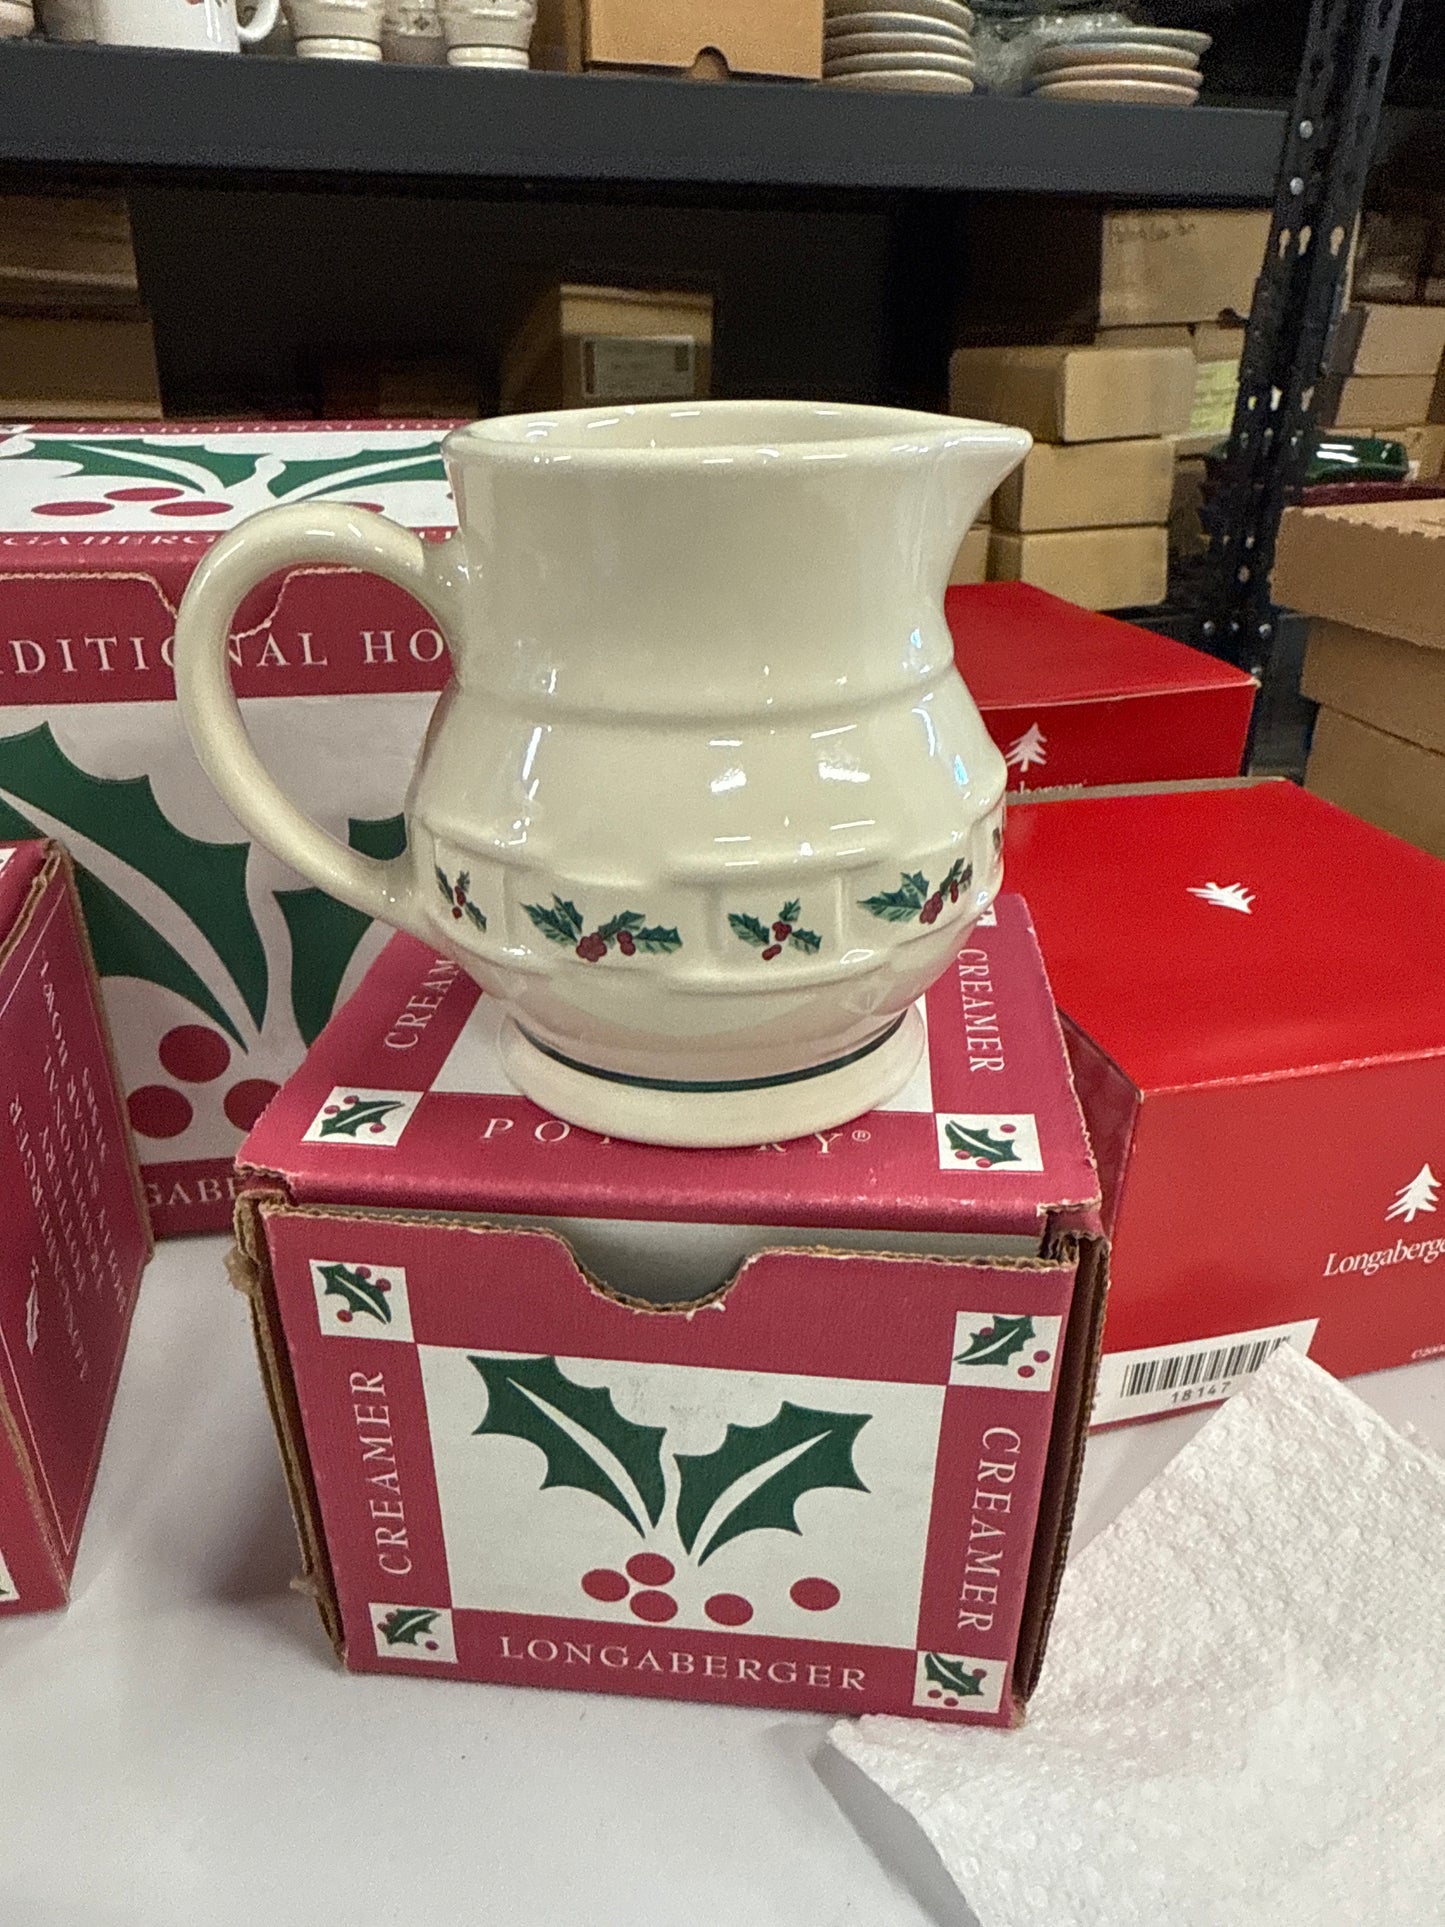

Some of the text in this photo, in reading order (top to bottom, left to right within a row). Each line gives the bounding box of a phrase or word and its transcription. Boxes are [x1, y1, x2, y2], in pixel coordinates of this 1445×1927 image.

[360, 628, 446, 664] HO
[384, 959, 461, 1050] CREAM
[957, 948, 1006, 1073] CREAMER
[1171, 1380, 1232, 1404] 18147
[349, 1371, 413, 1576] CREAMER
[957, 1426, 1021, 1633] CREAMER
[499, 1635, 867, 1691] LONGABERGER
